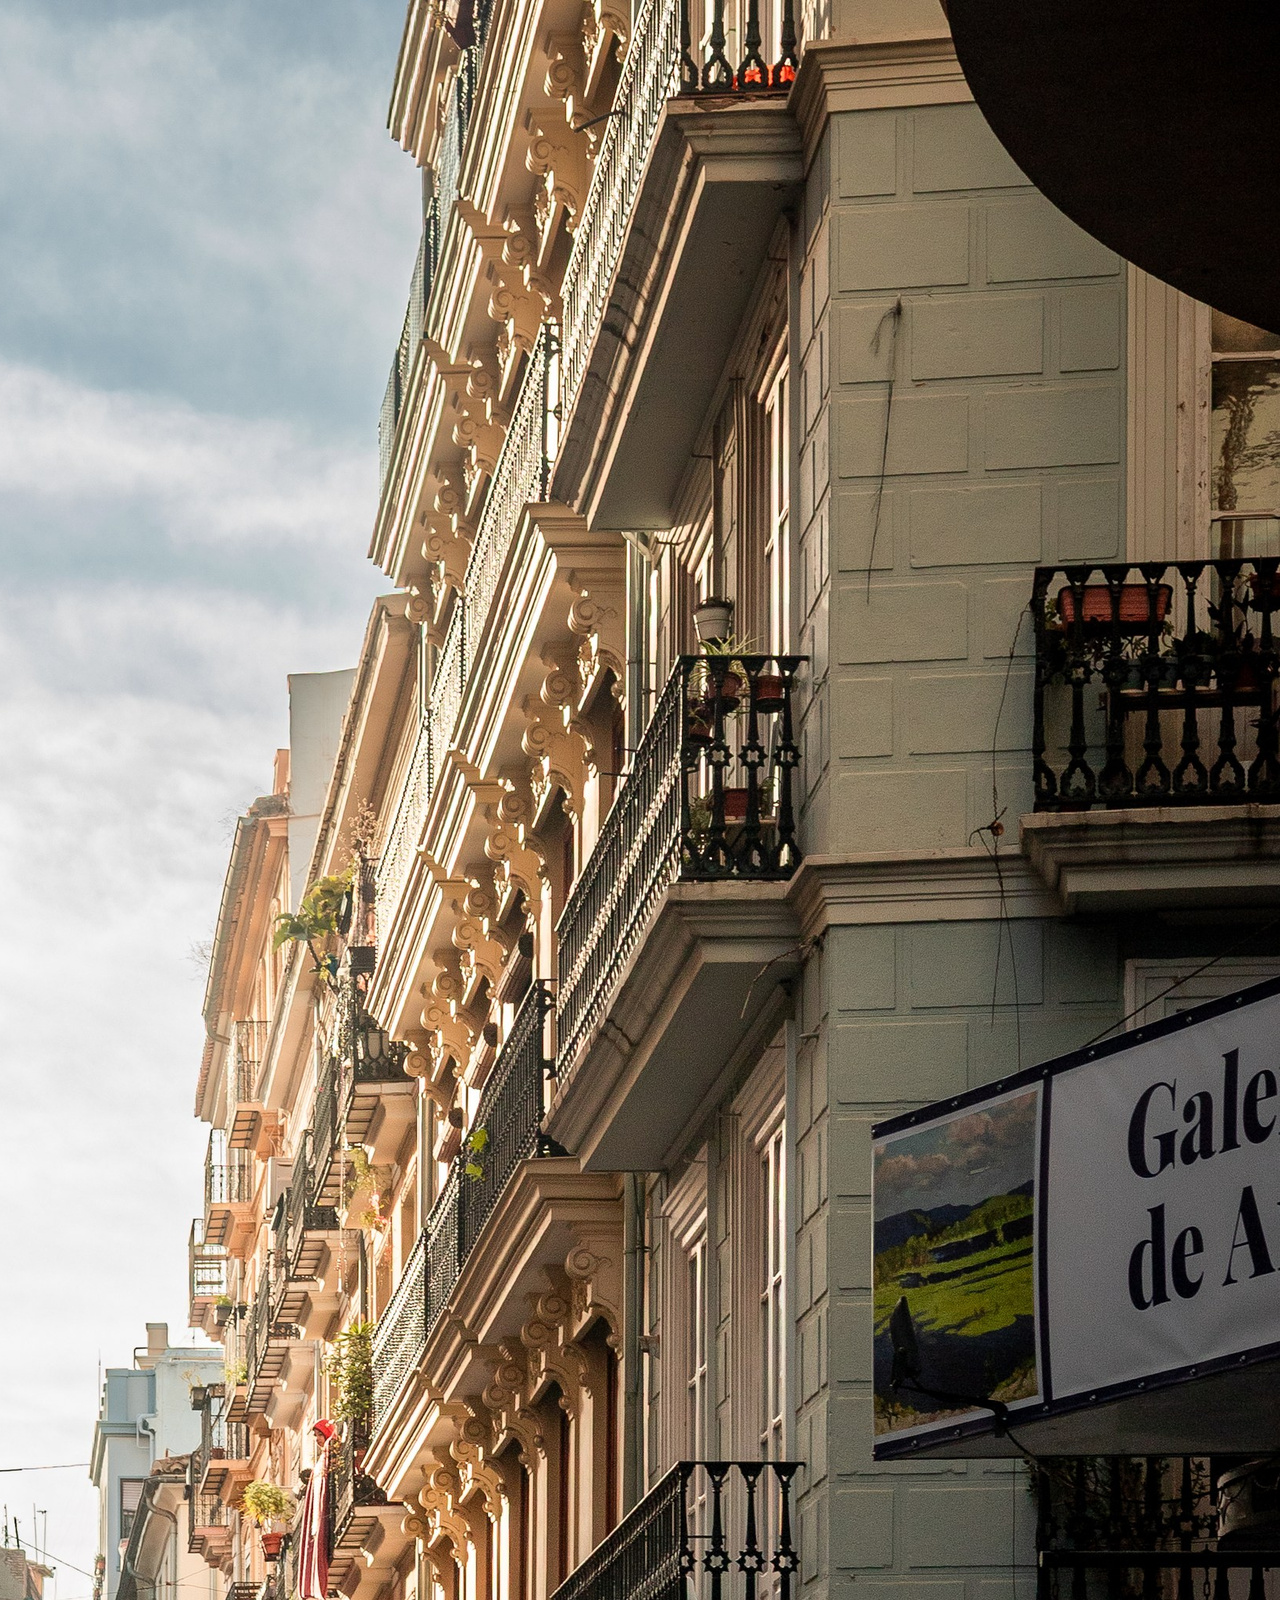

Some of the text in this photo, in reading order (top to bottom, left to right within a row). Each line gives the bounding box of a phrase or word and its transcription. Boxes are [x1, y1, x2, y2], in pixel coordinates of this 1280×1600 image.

[1127, 1047, 1280, 1179] Gale
[1128, 1185, 1280, 1311] de A
